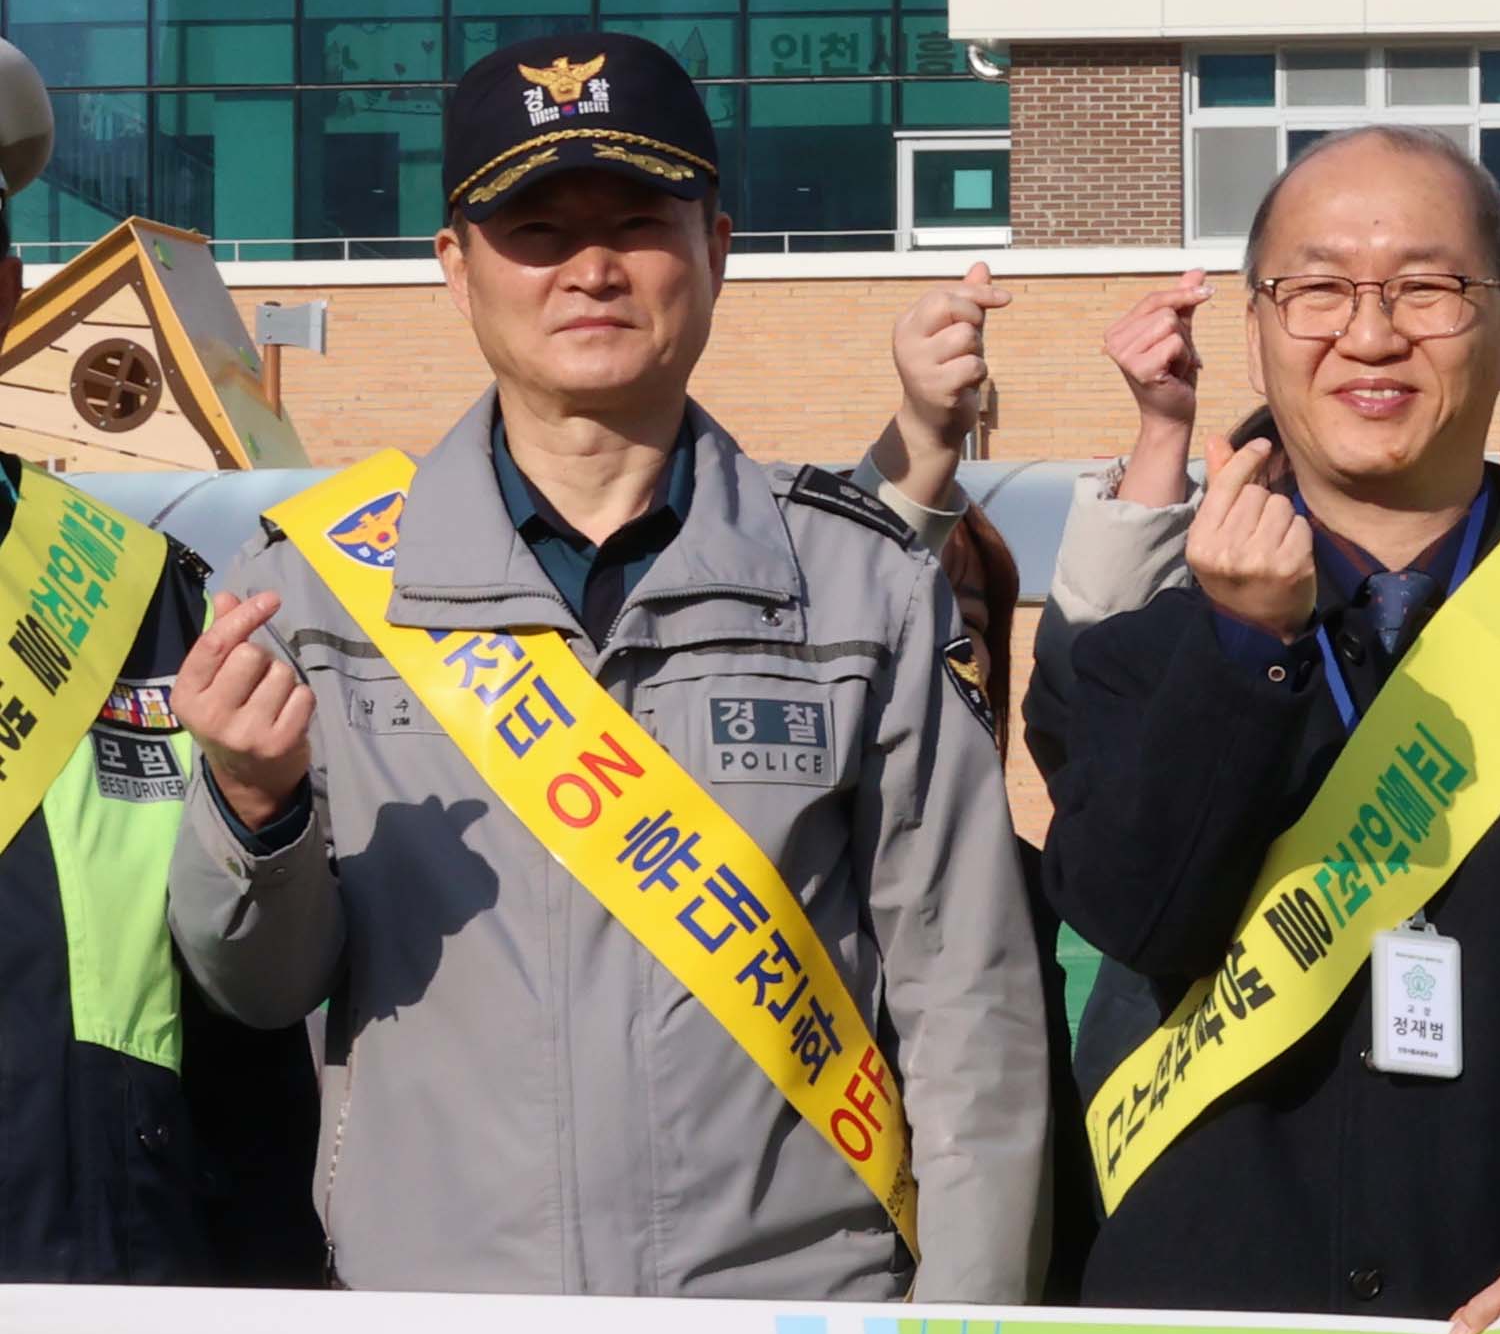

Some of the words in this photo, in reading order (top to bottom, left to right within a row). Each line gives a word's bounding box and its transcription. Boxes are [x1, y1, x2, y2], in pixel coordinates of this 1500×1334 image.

[719, 700, 818, 744] 경찰
[721, 751, 823, 774] POLICE
[431, 628, 577, 759] 전띠
[547, 732, 645, 829] ON
[616, 809, 844, 1085] 휴대전화
[829, 1045, 894, 1163] OFF
[1264, 721, 1470, 973] 교통안전을
